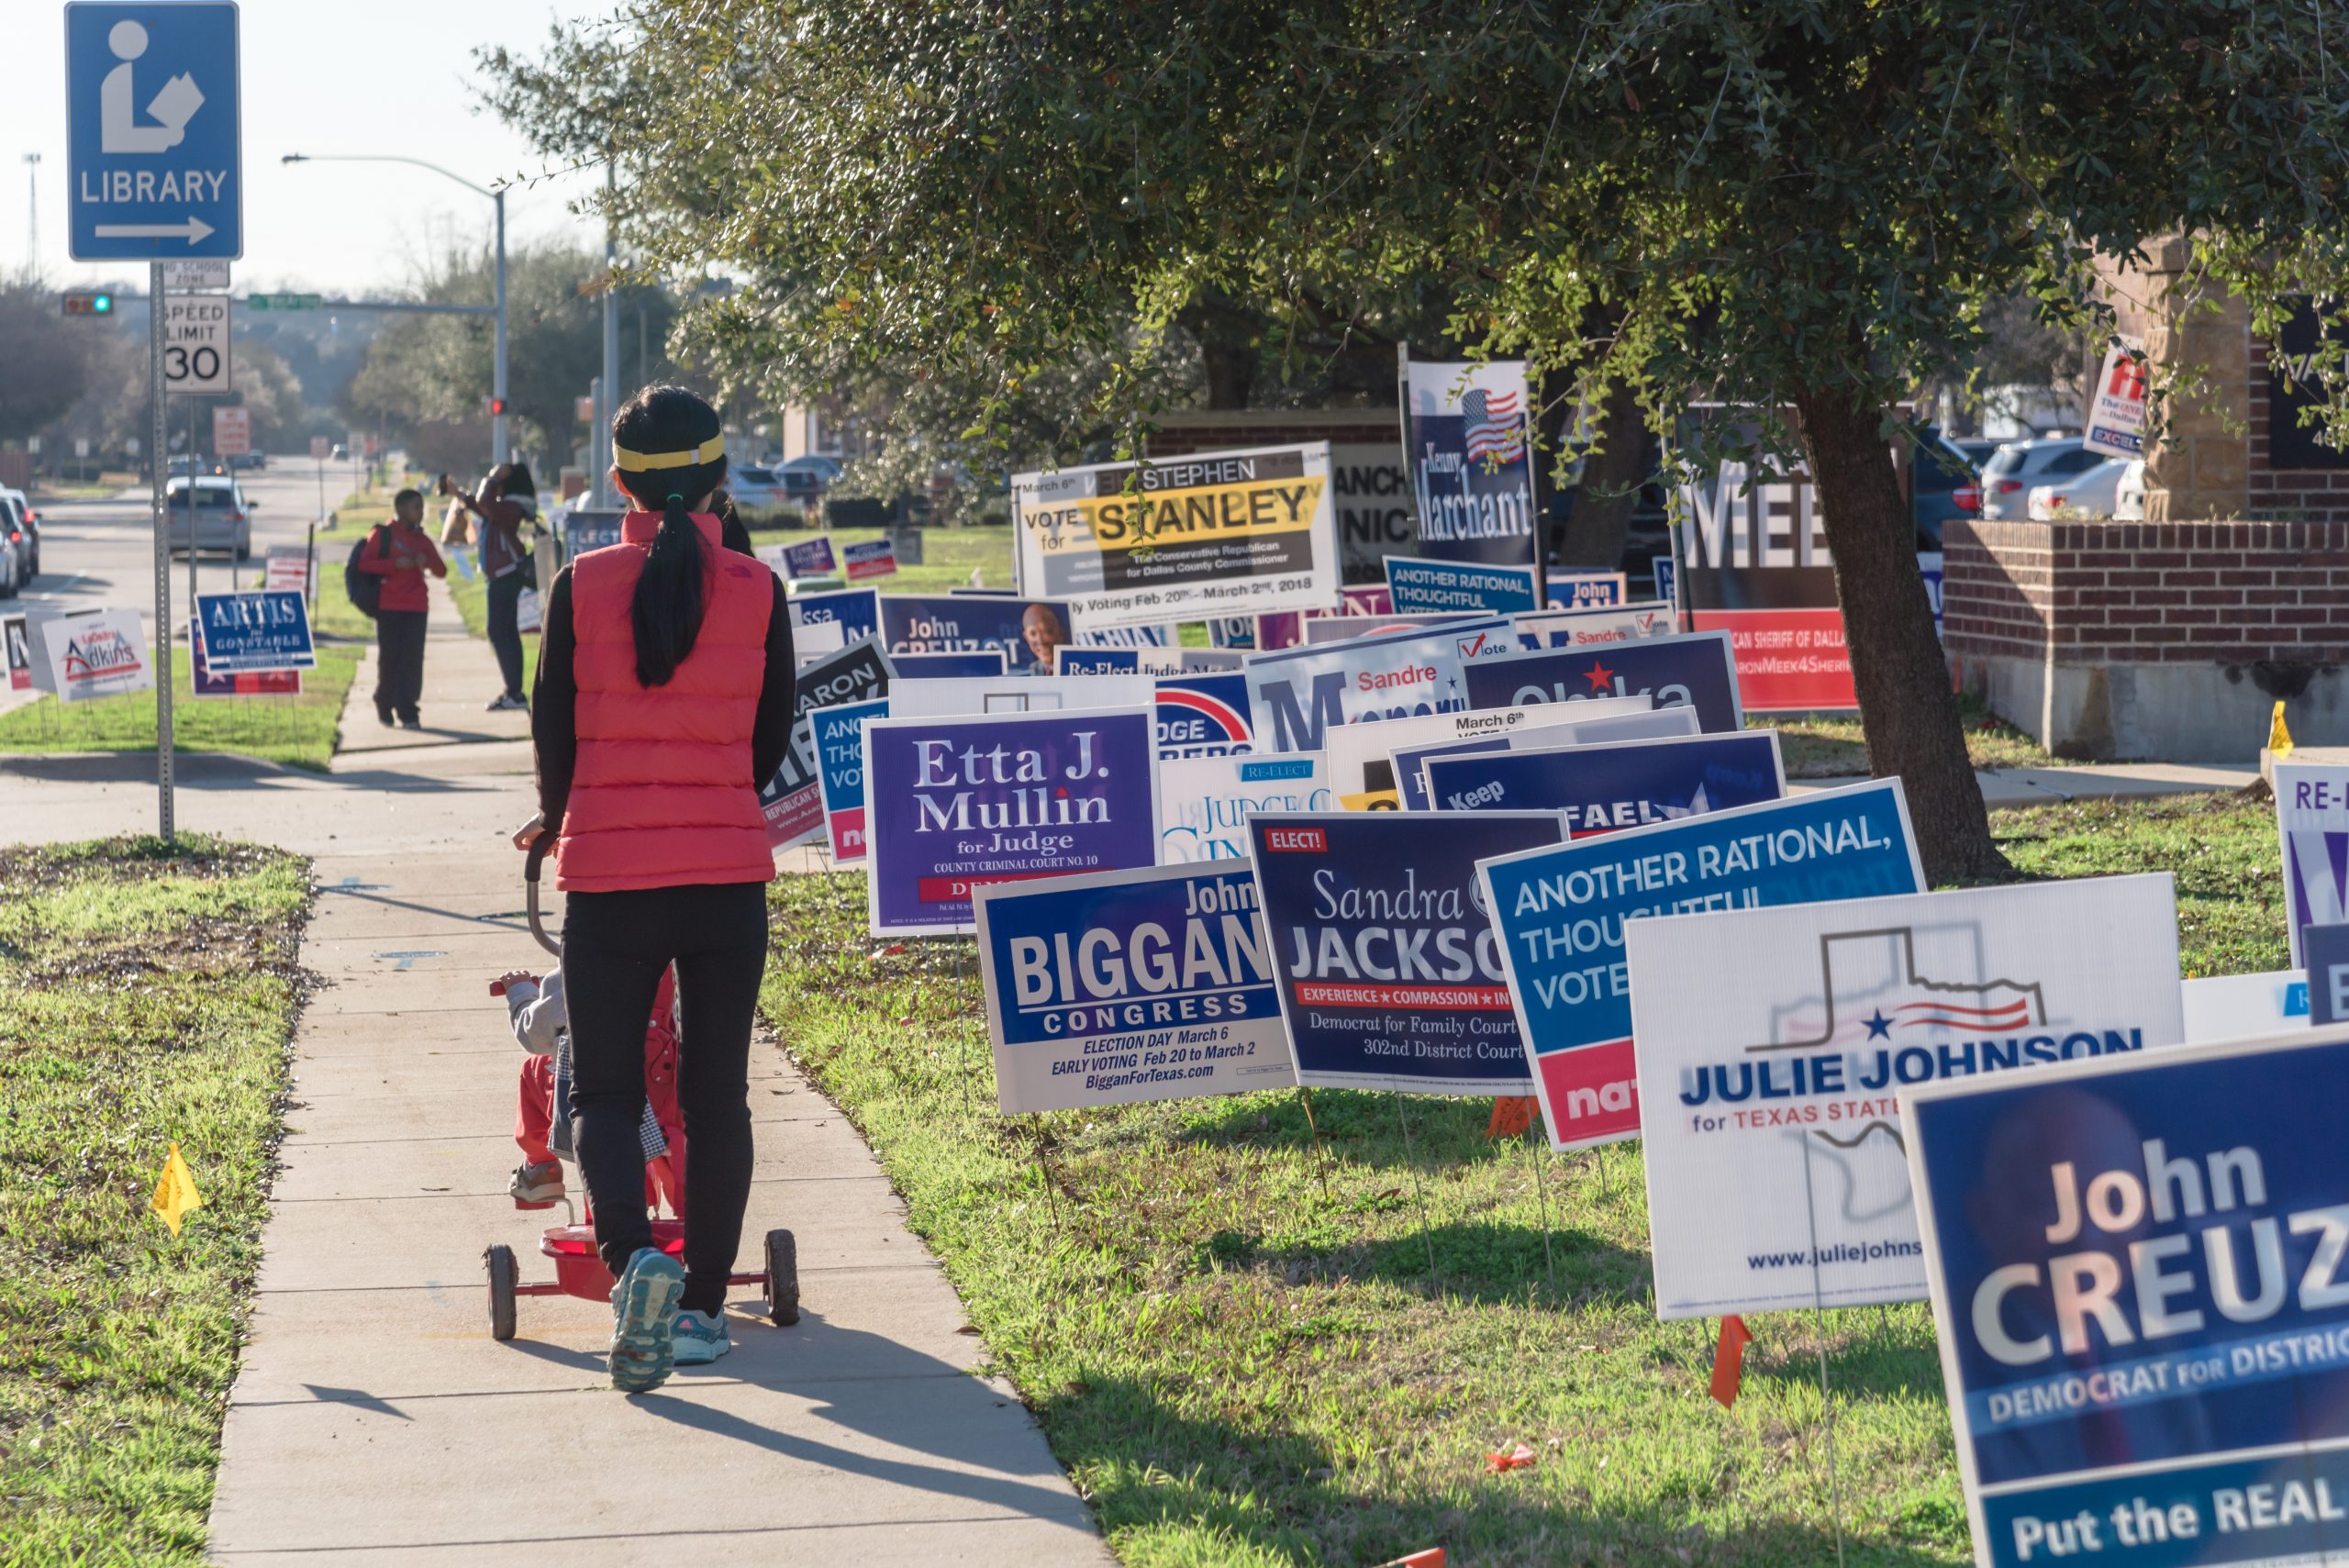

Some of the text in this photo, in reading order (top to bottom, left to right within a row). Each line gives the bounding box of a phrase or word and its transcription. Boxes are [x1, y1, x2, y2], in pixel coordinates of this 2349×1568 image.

[81, 170, 228, 203] LIBRARY
[175, 274, 206, 284] ZONE
[165, 326, 216, 341] LIMIT
[164, 346, 220, 381] 30
[1141, 459, 1256, 490] STEPHEN
[1425, 441, 1463, 483] Kenny
[1022, 482, 1059, 495] March
[1413, 458, 1534, 542] Marchant
[1024, 508, 1078, 530] VOTE
[1097, 485, 1308, 541] STANLEY
[1041, 535, 1065, 550] for
[1153, 548, 1220, 562] Conservative
[1221, 540, 1280, 556] Republican
[1126, 553, 1289, 579] for Dallas County Commissioner
[1394, 568, 1531, 595] ANOTHER RATIONAL,
[1087, 596, 1131, 612] Voting
[1134, 593, 1161, 606] Feb
[1203, 584, 1249, 599] March
[1279, 577, 1312, 593] 2018
[1395, 586, 1486, 608] THOUGHTFUL
[1572, 582, 1611, 599] John
[212, 597, 296, 628] ARTIS
[907, 616, 960, 639] John
[1575, 629, 1627, 645] Sandre
[1753, 630, 1794, 649] SHERIFF
[1795, 630, 1811, 648] OF
[1068, 662, 1134, 676] Re-Elect
[1357, 664, 1438, 692] Sandre
[794, 662, 877, 717] ARON
[1455, 711, 1525, 731] March 6th
[912, 731, 1109, 788] Etta J.
[765, 790, 812, 821] REPUBLICAN
[912, 785, 1112, 833] Mullin
[1446, 780, 1505, 811] Keep
[957, 830, 1074, 857] for Judge
[1270, 831, 1321, 850] ELECT!
[934, 855, 1099, 873] COUNTY CRIMINAL COURT NO. 10
[1514, 815, 1893, 917] ANOTHER RATIONAL,
[1185, 876, 1260, 917] John
[1312, 868, 1464, 920] Sandra
[1009, 911, 1275, 1006] BIGGAN
[1303, 987, 1379, 1004] EXPERIENCE
[1392, 990, 1479, 1006] COMPASSION
[1043, 994, 1248, 1035] CONGRESS
[1309, 1012, 1518, 1038] Democrat for Family Court
[1083, 1026, 1230, 1055] ELECTION DAY March 6
[1364, 1038, 1525, 1059] 302nd District Court
[1052, 1041, 1256, 1076] EARLY VOTING Feb 20 to March 2
[1678, 1027, 2143, 1107] JULIE JOHNSON
[1085, 1065, 1214, 1091] BigganForTexas.com
[1567, 1081, 1638, 1120] na
[1692, 1113, 1727, 1135] for
[1733, 1105, 1819, 1129] TEXAS
[2044, 1138, 2268, 1244] John
[1746, 1240, 1923, 1272] www.juliejohns
[1970, 1203, 2349, 1365] CREUZ
[1987, 1360, 2169, 1423] DEMOCRAT
[2176, 1359, 2226, 1385] FOR
[2011, 1477, 2346, 1560] Put the REAL
